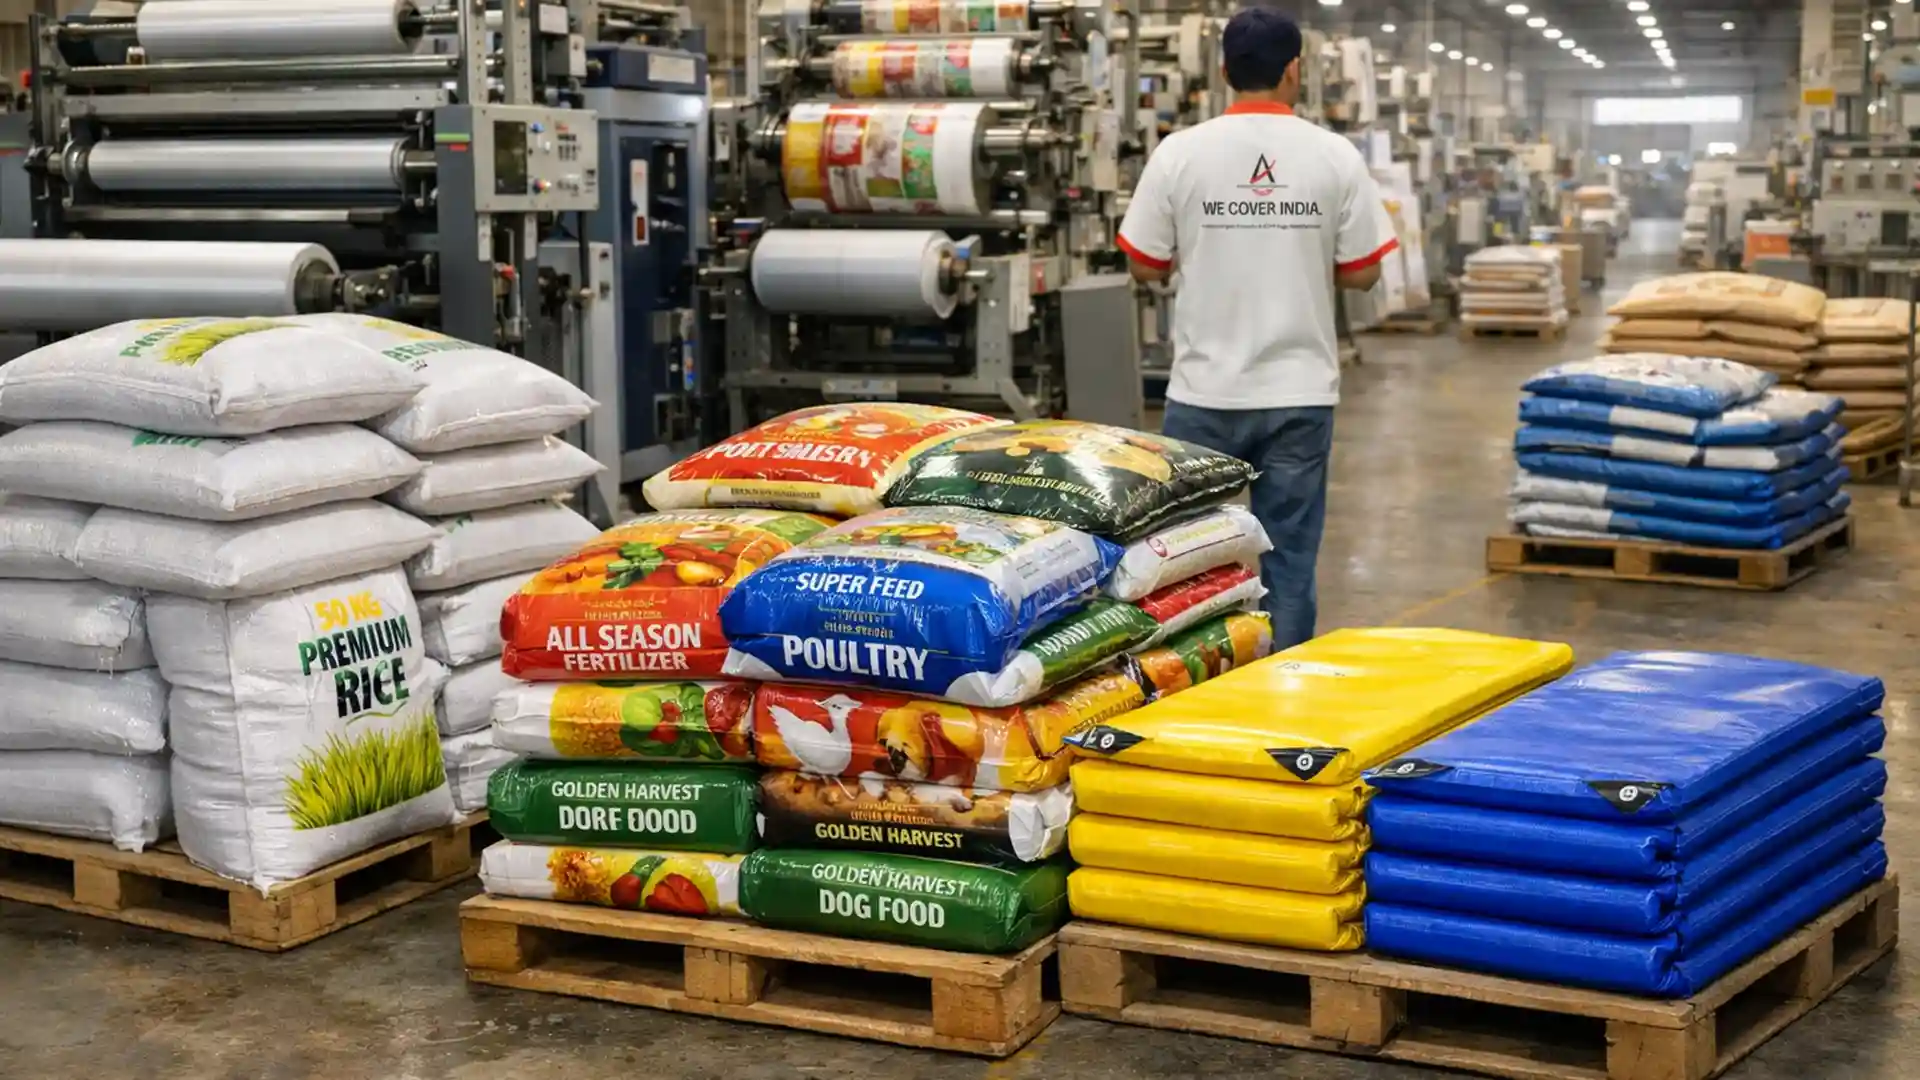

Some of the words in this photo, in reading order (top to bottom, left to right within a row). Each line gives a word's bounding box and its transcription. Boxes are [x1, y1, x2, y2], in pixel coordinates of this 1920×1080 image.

[1203, 201, 1225, 215] WE
[1228, 201, 1276, 215] COVER
[795, 572, 868, 594] SUPER
[869, 576, 924, 600] FEED
[314, 598, 348, 630] 50
[348, 590, 383, 621] KG
[298, 614, 412, 676] PREMIUM
[547, 626, 594, 651] ALL
[598, 623, 701, 650] SEASON
[563, 652, 690, 671] FERTILIZER
[783, 635, 928, 681] POULTRY
[334, 657, 410, 718] RICE
[551, 781, 620, 799] GOLDEN
[624, 783, 703, 801] HARVEST
[815, 823, 884, 842] GOLDEN
[887, 826, 964, 849] HARVEST
[811, 863, 883, 887] GOLDEN
[885, 871, 970, 897] HARVEST
[819, 888, 872, 919] DOG
[878, 895, 945, 928] FOOD
